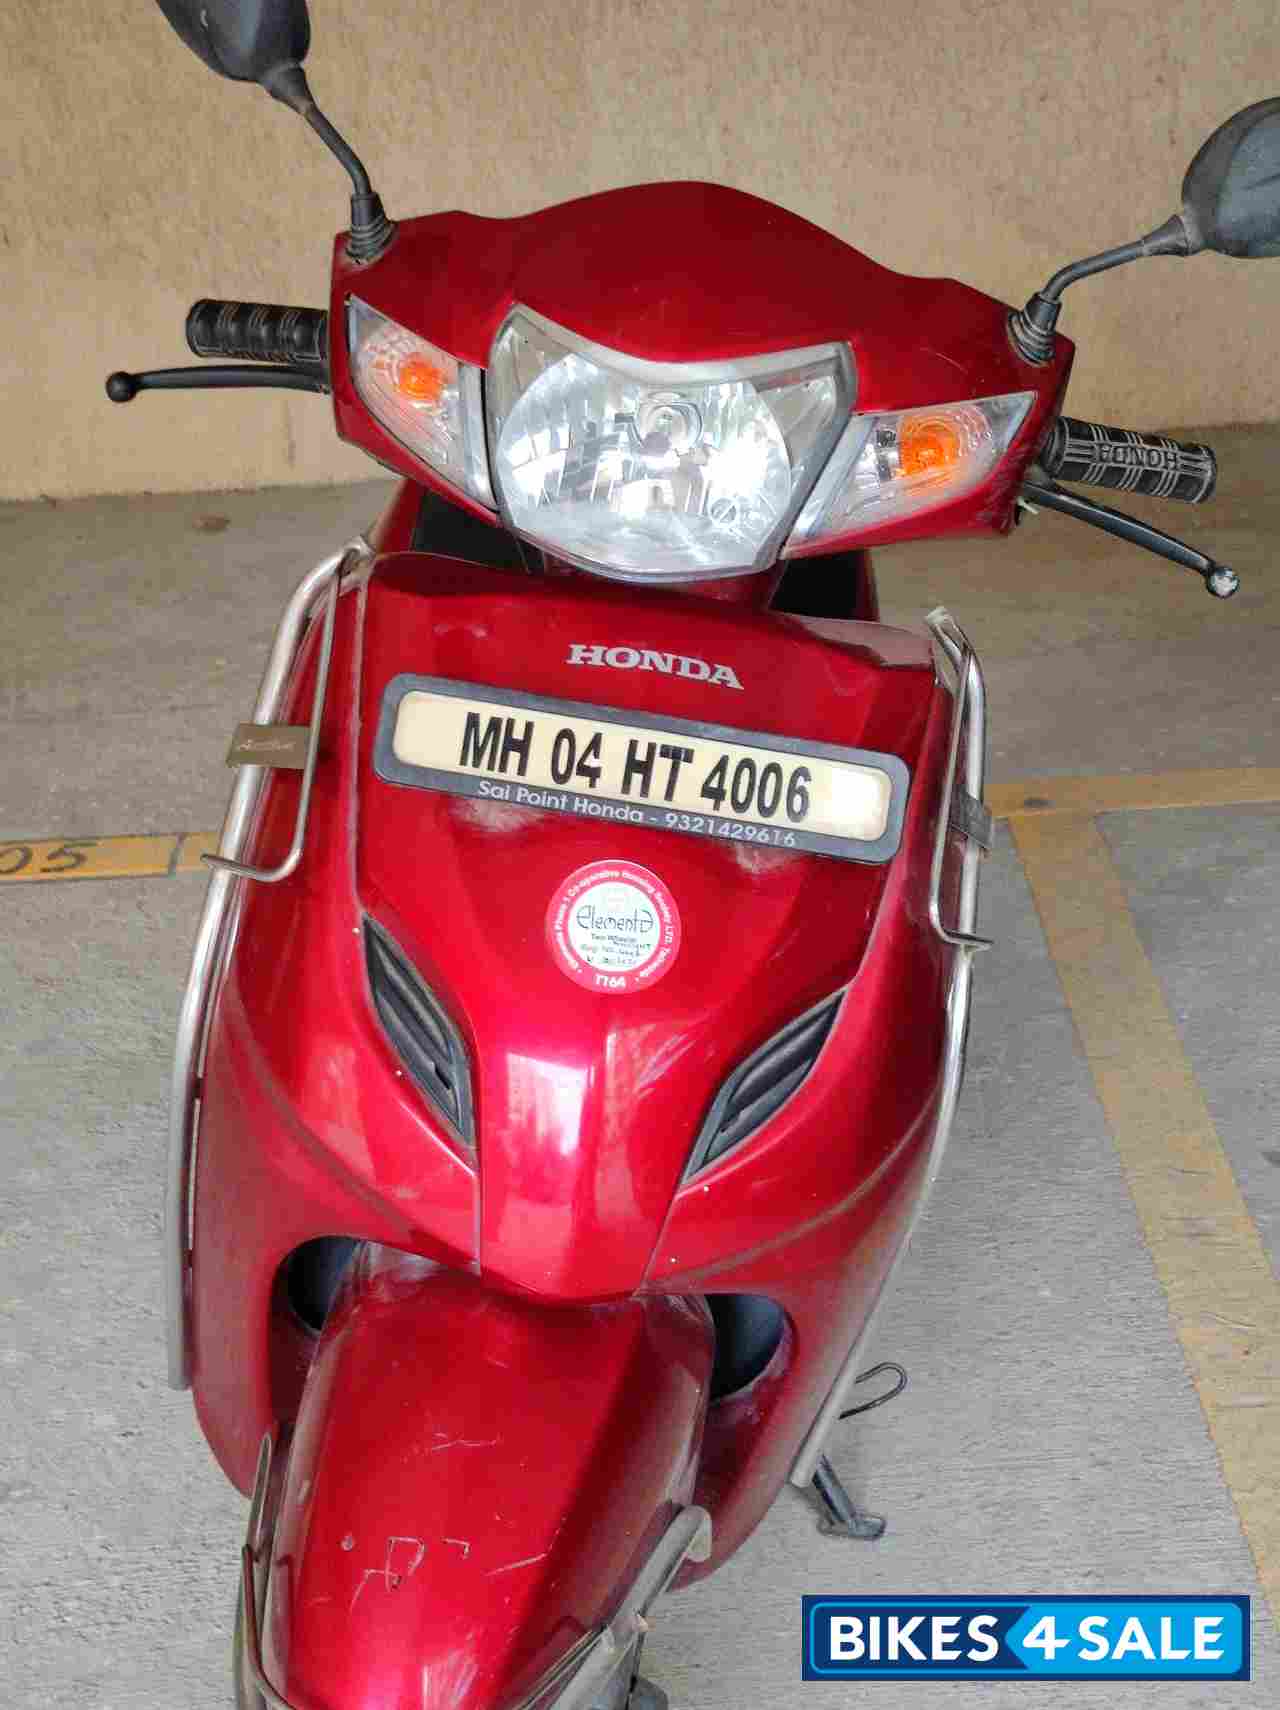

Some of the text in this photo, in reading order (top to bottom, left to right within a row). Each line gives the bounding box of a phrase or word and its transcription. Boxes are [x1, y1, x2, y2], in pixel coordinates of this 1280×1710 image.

[566, 643, 744, 690] HONDA
[458, 711, 813, 823] MH 04 HT 4006
[479, 780, 511, 801] Sai
[516, 786, 569, 810] Point
[572, 796, 644, 823] Honda
